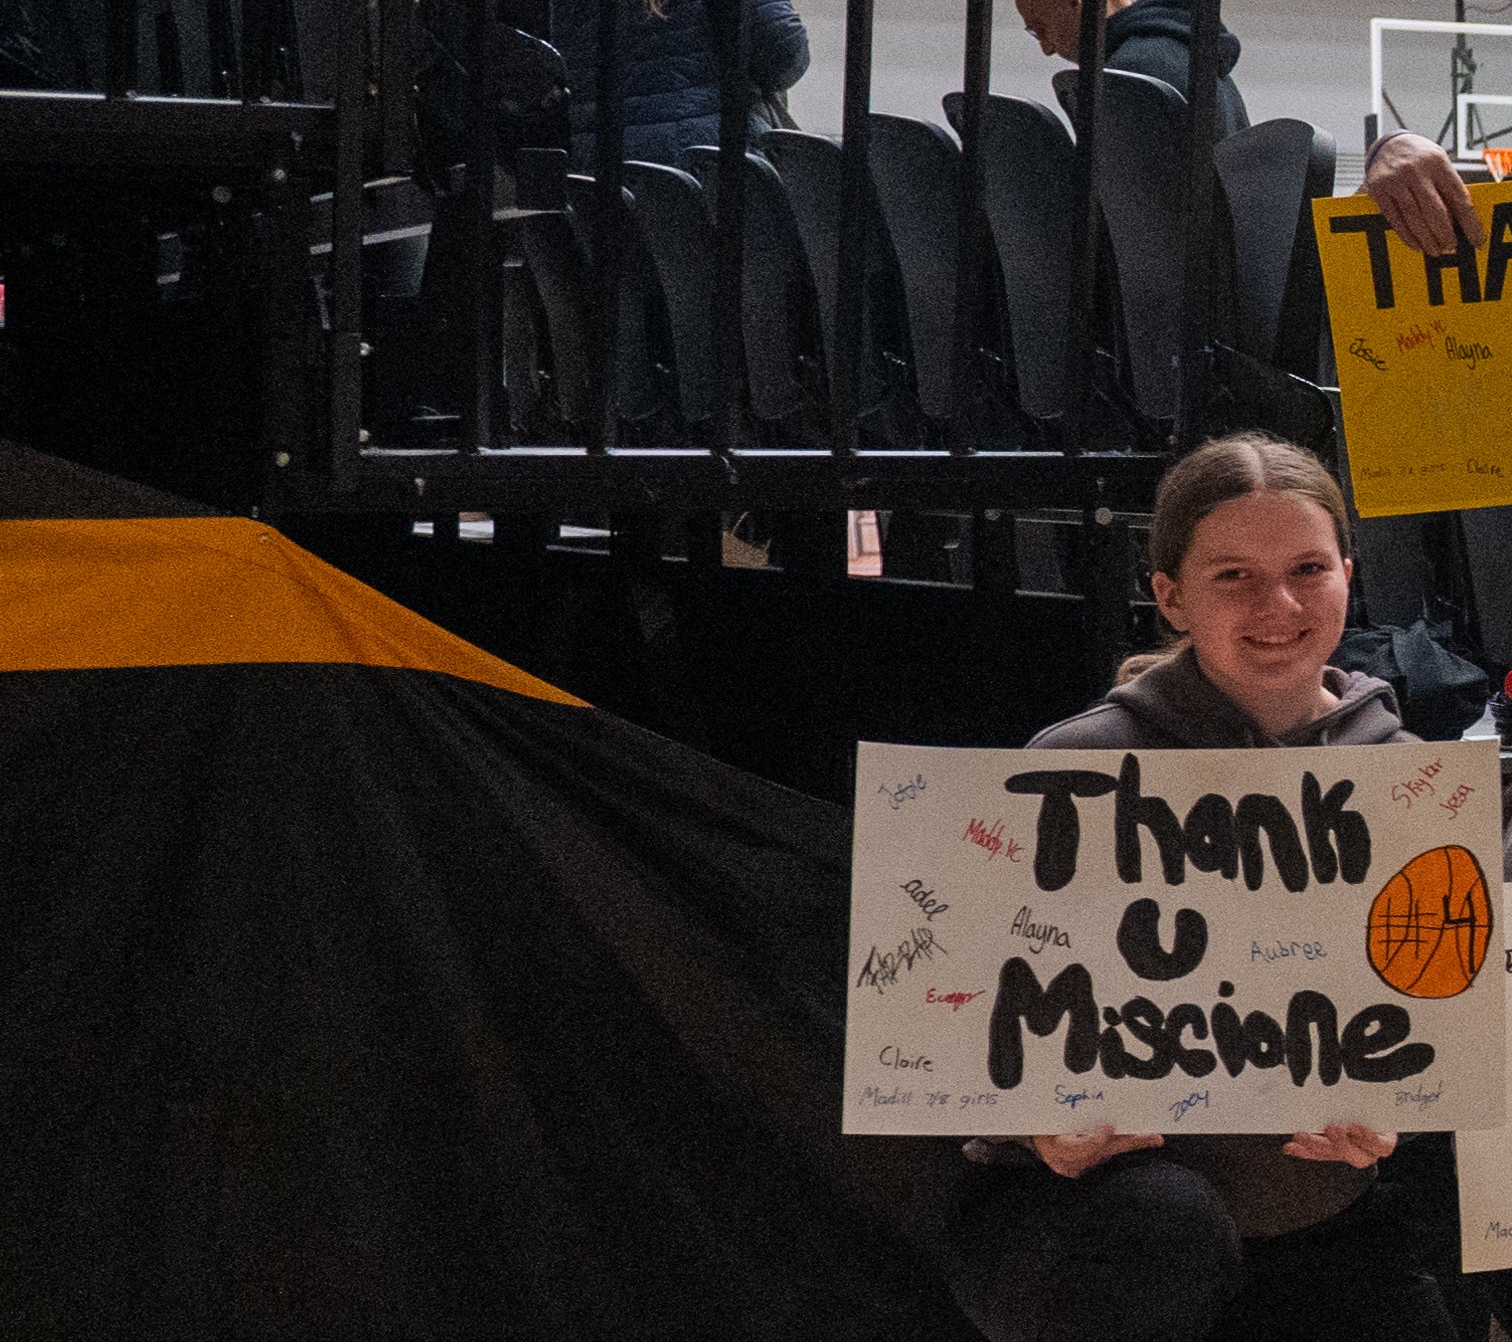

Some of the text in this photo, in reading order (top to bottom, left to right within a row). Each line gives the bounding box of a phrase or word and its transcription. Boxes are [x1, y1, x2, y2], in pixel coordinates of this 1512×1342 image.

[1444, 335, 1494, 370] Alayna
[1003, 752, 1373, 894] Thank
[1010, 904, 1072, 955] Alayna
[1250, 939, 1328, 963] Aubree
[987, 956, 1437, 1091] Miscione
[878, 1045, 935, 1073] Claire
